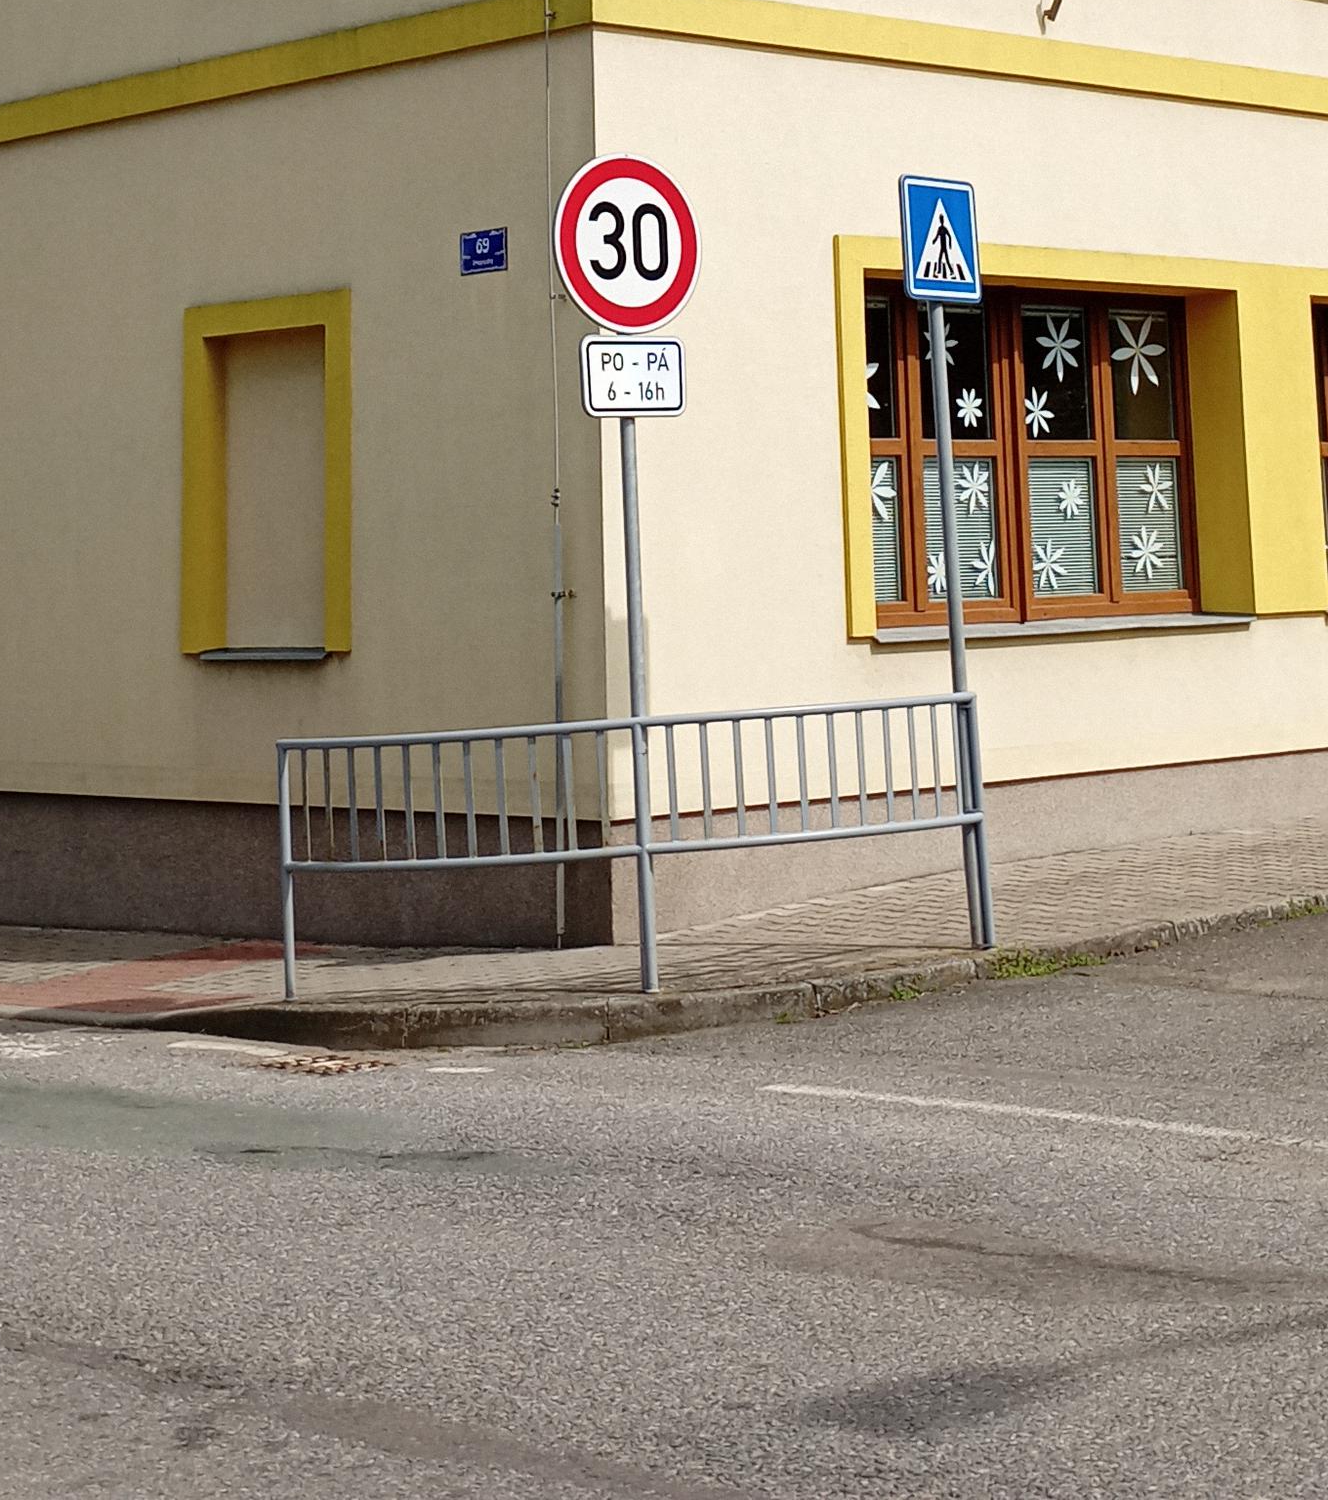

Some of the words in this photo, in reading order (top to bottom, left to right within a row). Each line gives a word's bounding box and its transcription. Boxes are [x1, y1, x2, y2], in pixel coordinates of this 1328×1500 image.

[475, 238, 490, 255] 69
[588, 201, 669, 281] 30
[601, 352, 624, 371] PO
[647, 347, 670, 371] PÁ
[607, 381, 616, 401] 6
[638, 381, 665, 401] 16h
